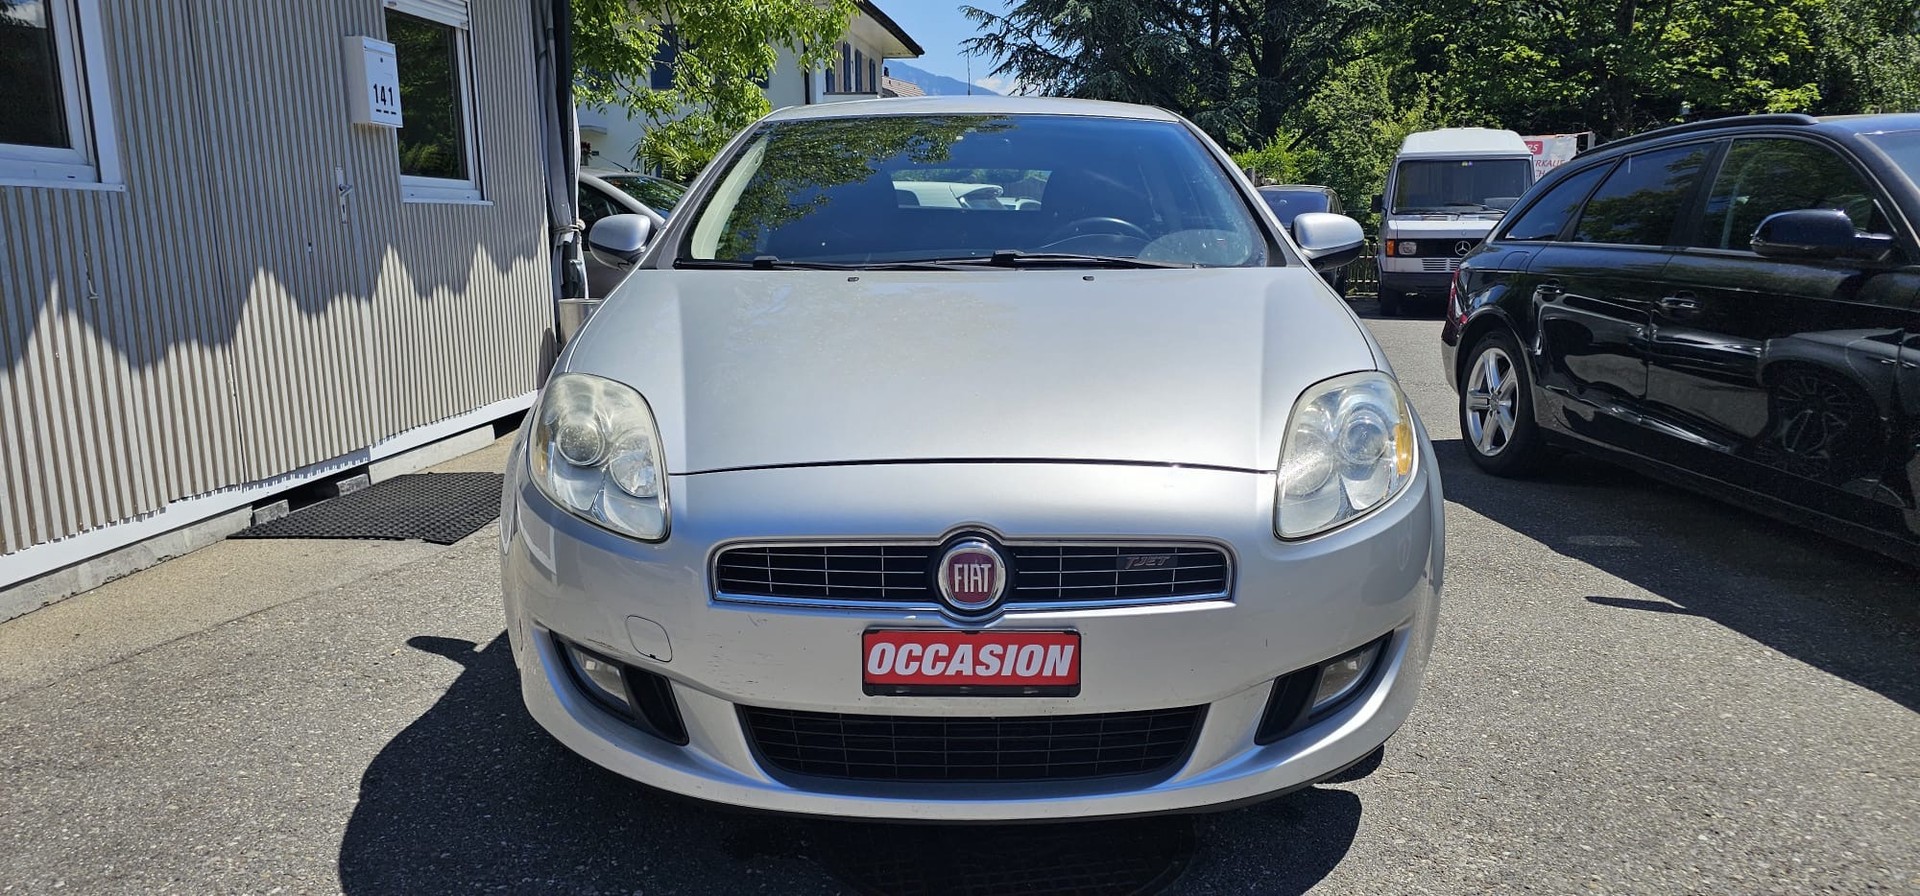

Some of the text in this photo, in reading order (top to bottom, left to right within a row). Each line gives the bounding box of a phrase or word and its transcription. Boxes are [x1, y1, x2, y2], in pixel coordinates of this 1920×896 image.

[373, 83, 394, 106] 141
[954, 563, 992, 592] FIAT
[867, 642, 1075, 677] OCCASION
